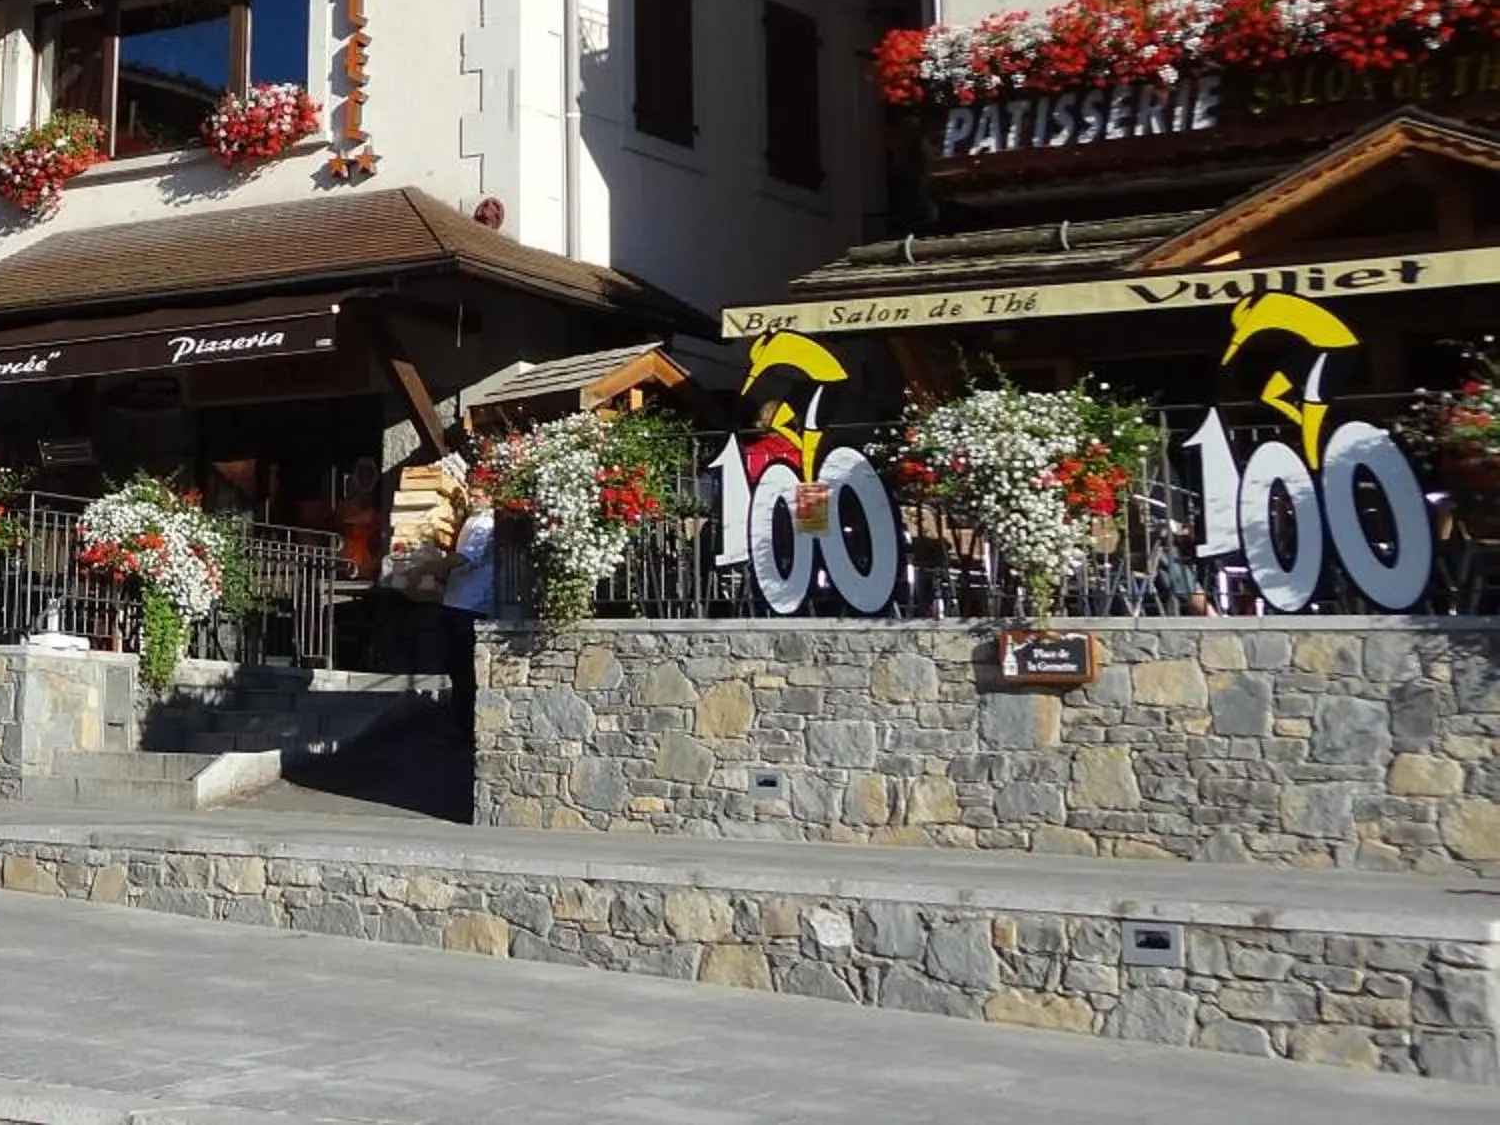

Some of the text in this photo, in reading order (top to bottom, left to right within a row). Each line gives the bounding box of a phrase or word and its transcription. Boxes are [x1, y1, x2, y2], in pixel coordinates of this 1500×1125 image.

[942, 75, 1220, 158] PATISSERIE
[167, 331, 285, 364] Pizzeria
[744, 292, 1039, 331] Bar Salon de Thé
[707, 431, 898, 615] 100
[1181, 406, 1433, 612] 100
